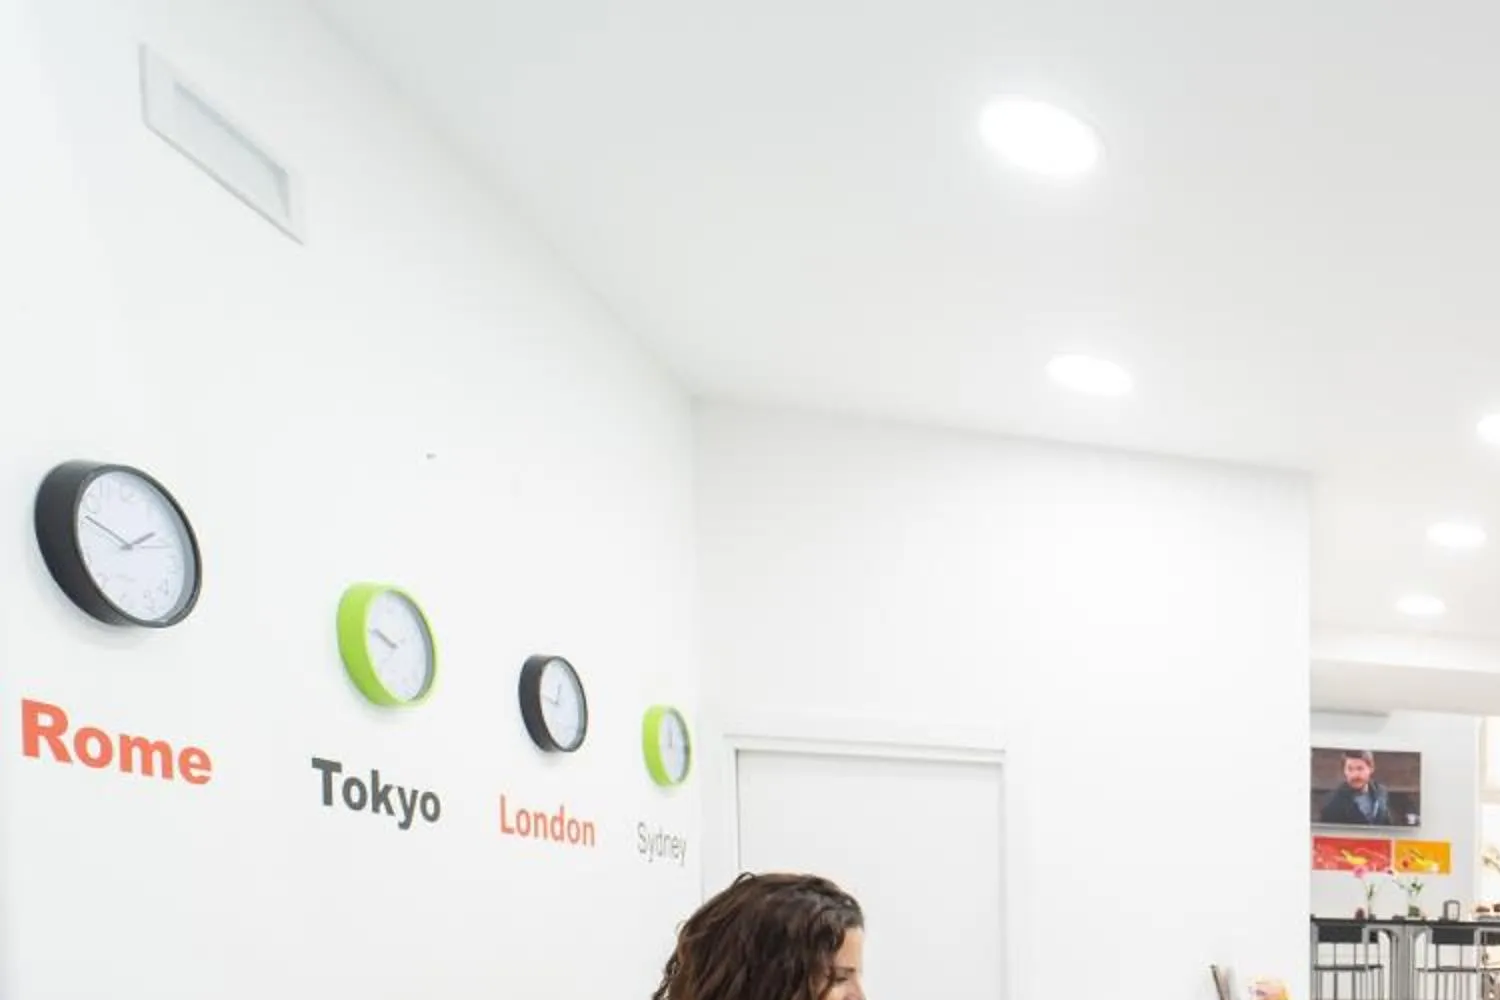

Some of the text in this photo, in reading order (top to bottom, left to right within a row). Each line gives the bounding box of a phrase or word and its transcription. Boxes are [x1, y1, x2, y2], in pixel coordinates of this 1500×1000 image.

[21, 699, 212, 785] Rome
[311, 757, 442, 830] Tokyo
[499, 795, 596, 847] London
[636, 822, 687, 867] Sydney
